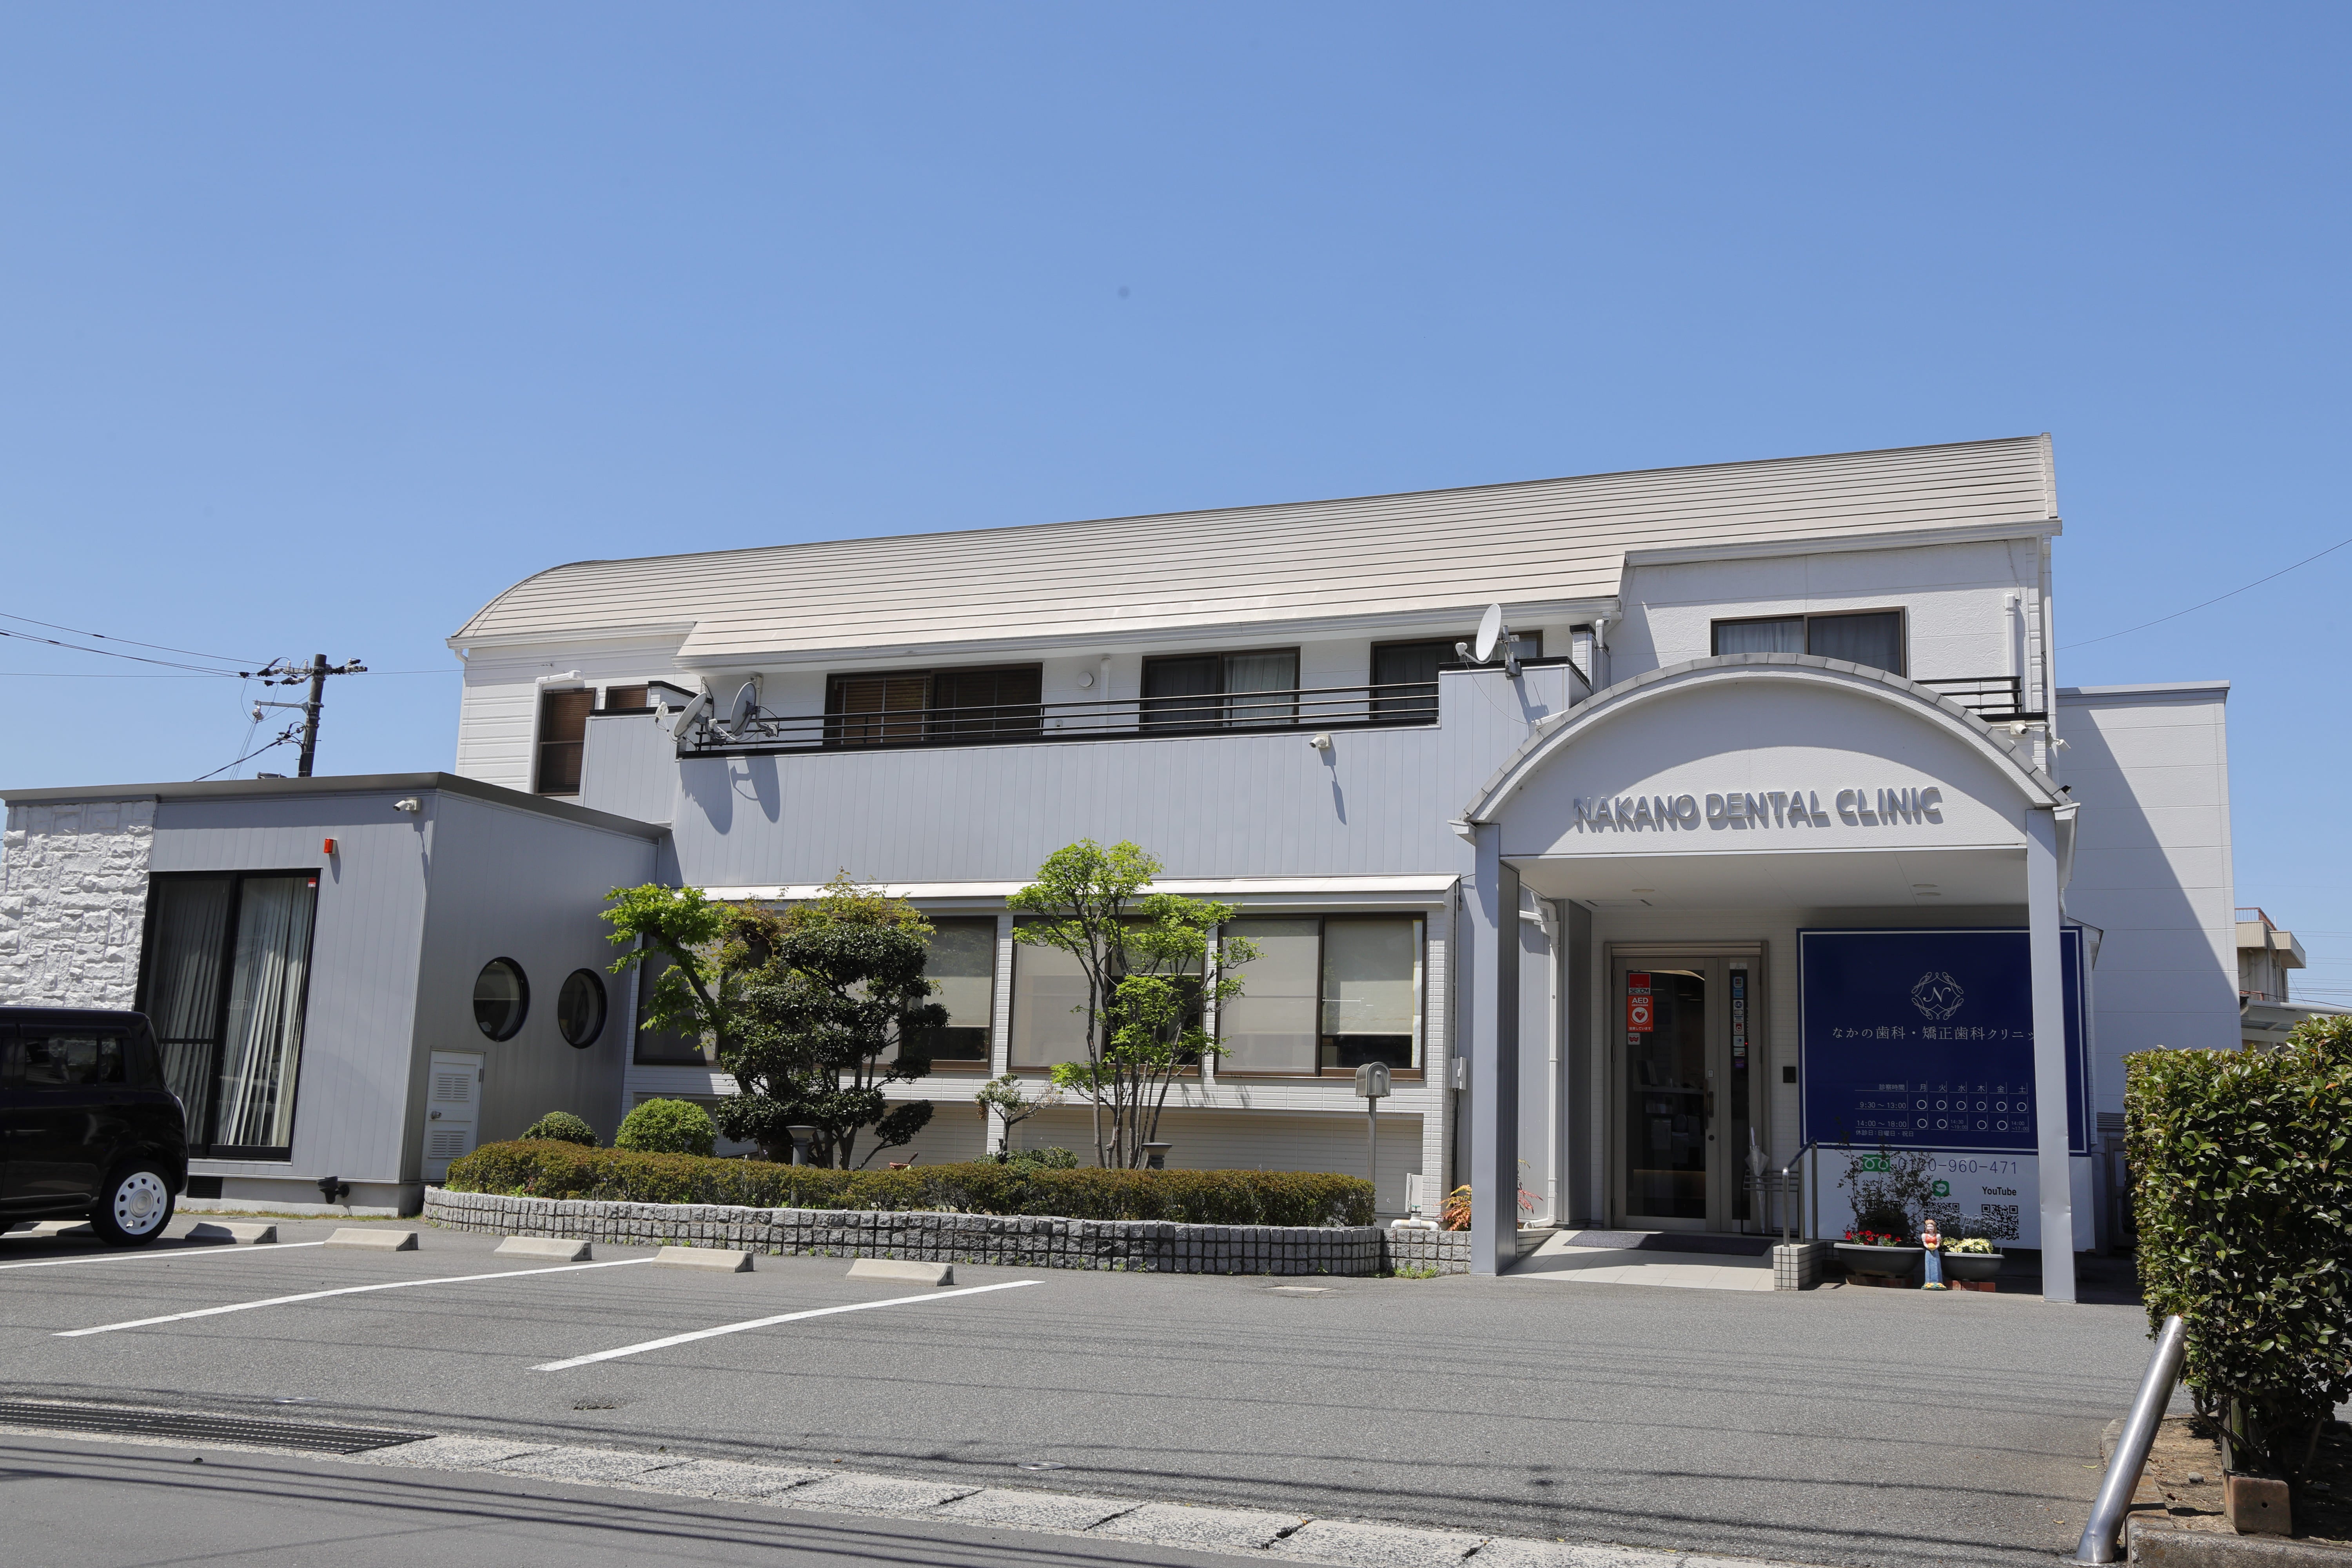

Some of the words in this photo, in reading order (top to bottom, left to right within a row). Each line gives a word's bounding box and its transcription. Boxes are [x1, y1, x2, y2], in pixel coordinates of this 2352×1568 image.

[1573, 793, 1697, 822] NAKANO
[1705, 790, 1827, 818] DENTAL
[1836, 786, 1939, 815] CLINIC
[1923, 987, 1951, 1003] N
[1832, 1025, 2034, 1041] なかの歯科・矯正歯科クリニッ
[1898, 1158, 2016, 1174] 0120-960-471
[1982, 1186, 2017, 1196] YouTube
